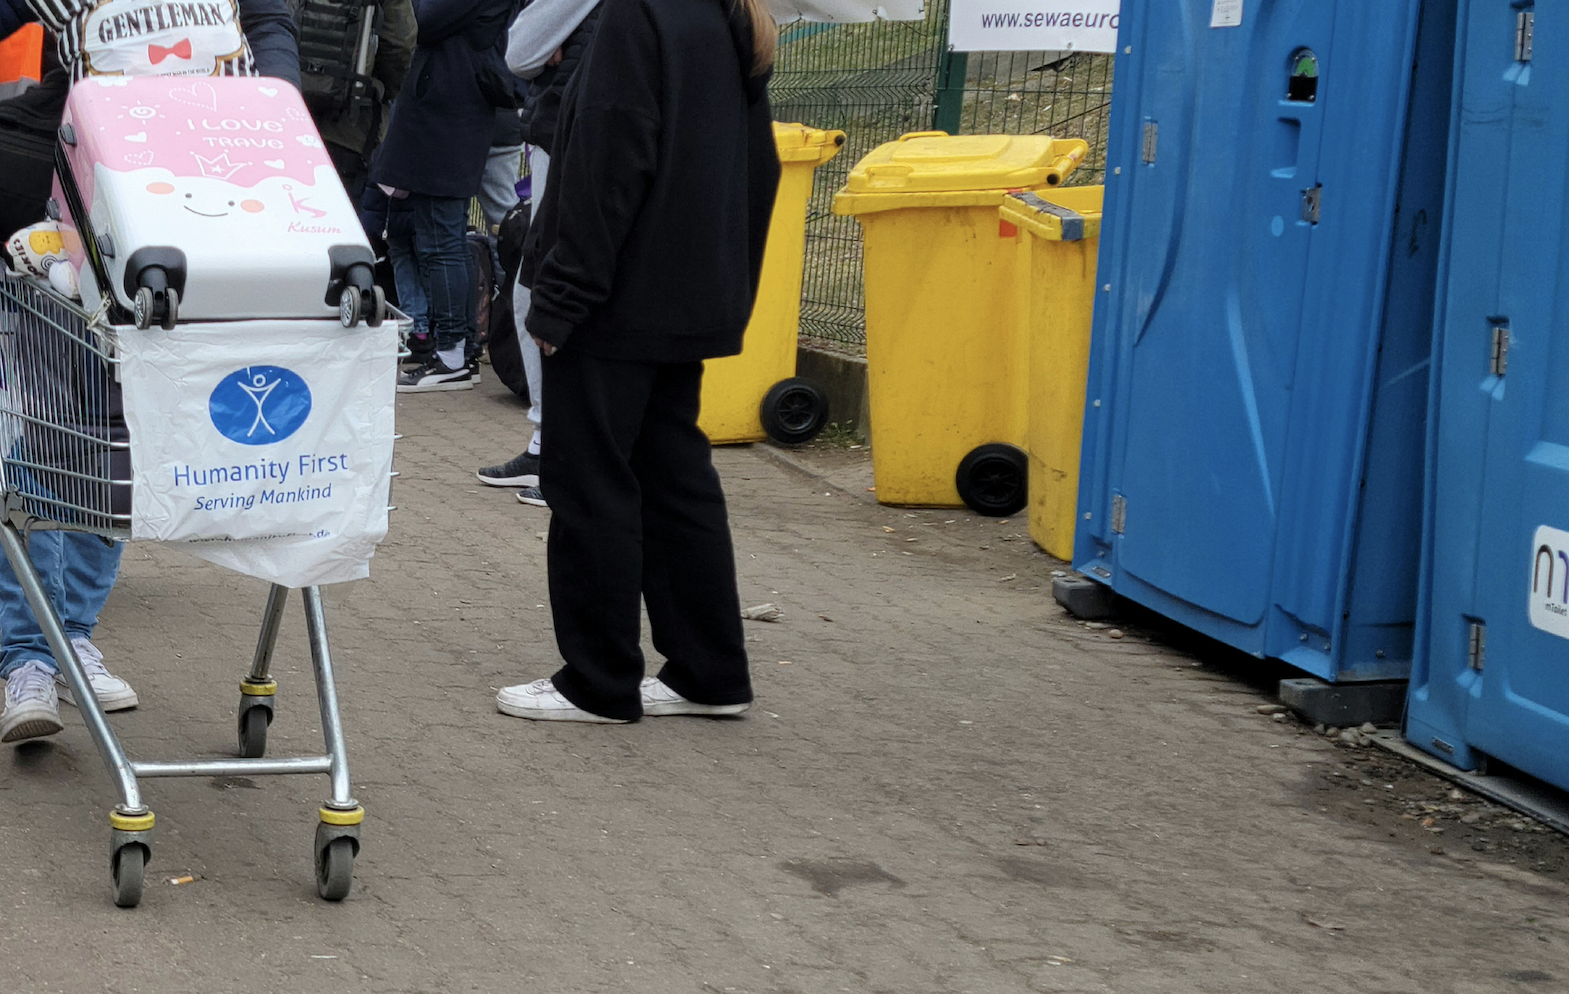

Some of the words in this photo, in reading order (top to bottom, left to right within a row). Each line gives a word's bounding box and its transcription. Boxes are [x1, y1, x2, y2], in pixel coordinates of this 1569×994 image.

[98, 1, 226, 44] GENTLEMAN
[187, 118, 196, 131] I
[201, 118, 284, 133] LOVE
[287, 221, 342, 235] Kusum
[173, 458, 290, 487] Humanity
[298, 453, 348, 476] First
[194, 492, 255, 511] Serving
[260, 482, 332, 505] Mankind
